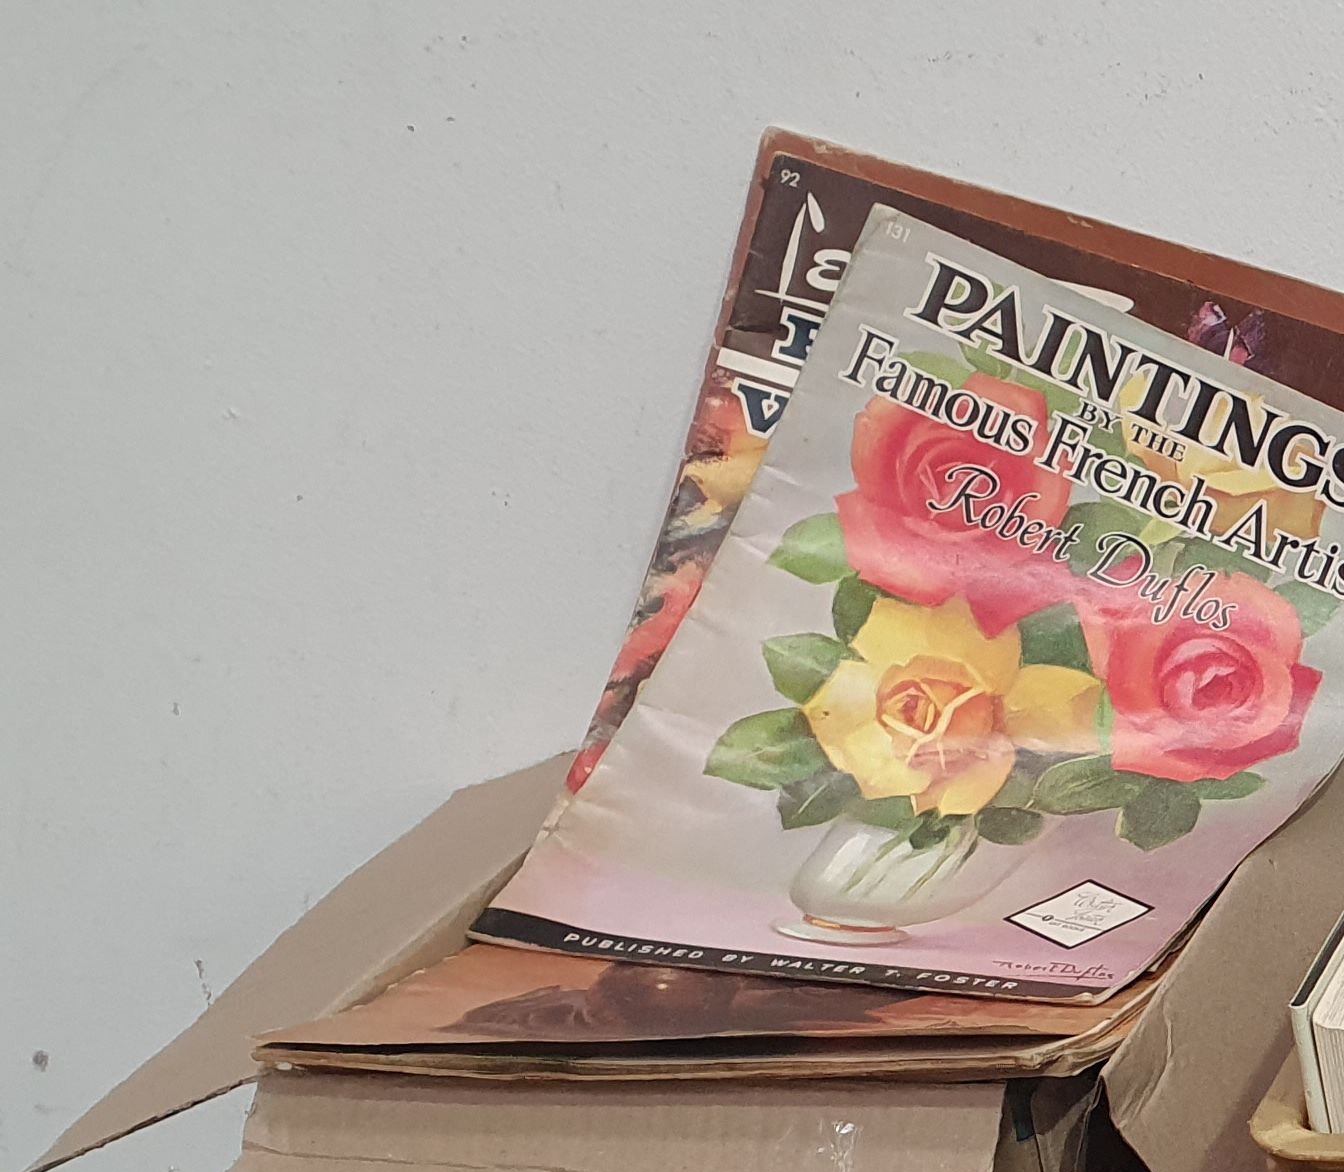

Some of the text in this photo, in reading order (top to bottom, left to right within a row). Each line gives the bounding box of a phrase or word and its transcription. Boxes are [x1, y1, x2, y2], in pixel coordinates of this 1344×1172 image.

[780, 168, 800, 187] 92
[884, 220, 911, 243] 131
[842, 330, 1035, 454] Famous
[1042, 420, 1214, 535] French
[1081, 402, 1186, 463] BY THE
[929, 464, 1236, 630] Robert Duflos
[564, 932, 704, 960] PUBLISHED
[721, 953, 755, 965] BY
[770, 957, 866, 975] WALTER
[916, 971, 1019, 990] FOSTER
